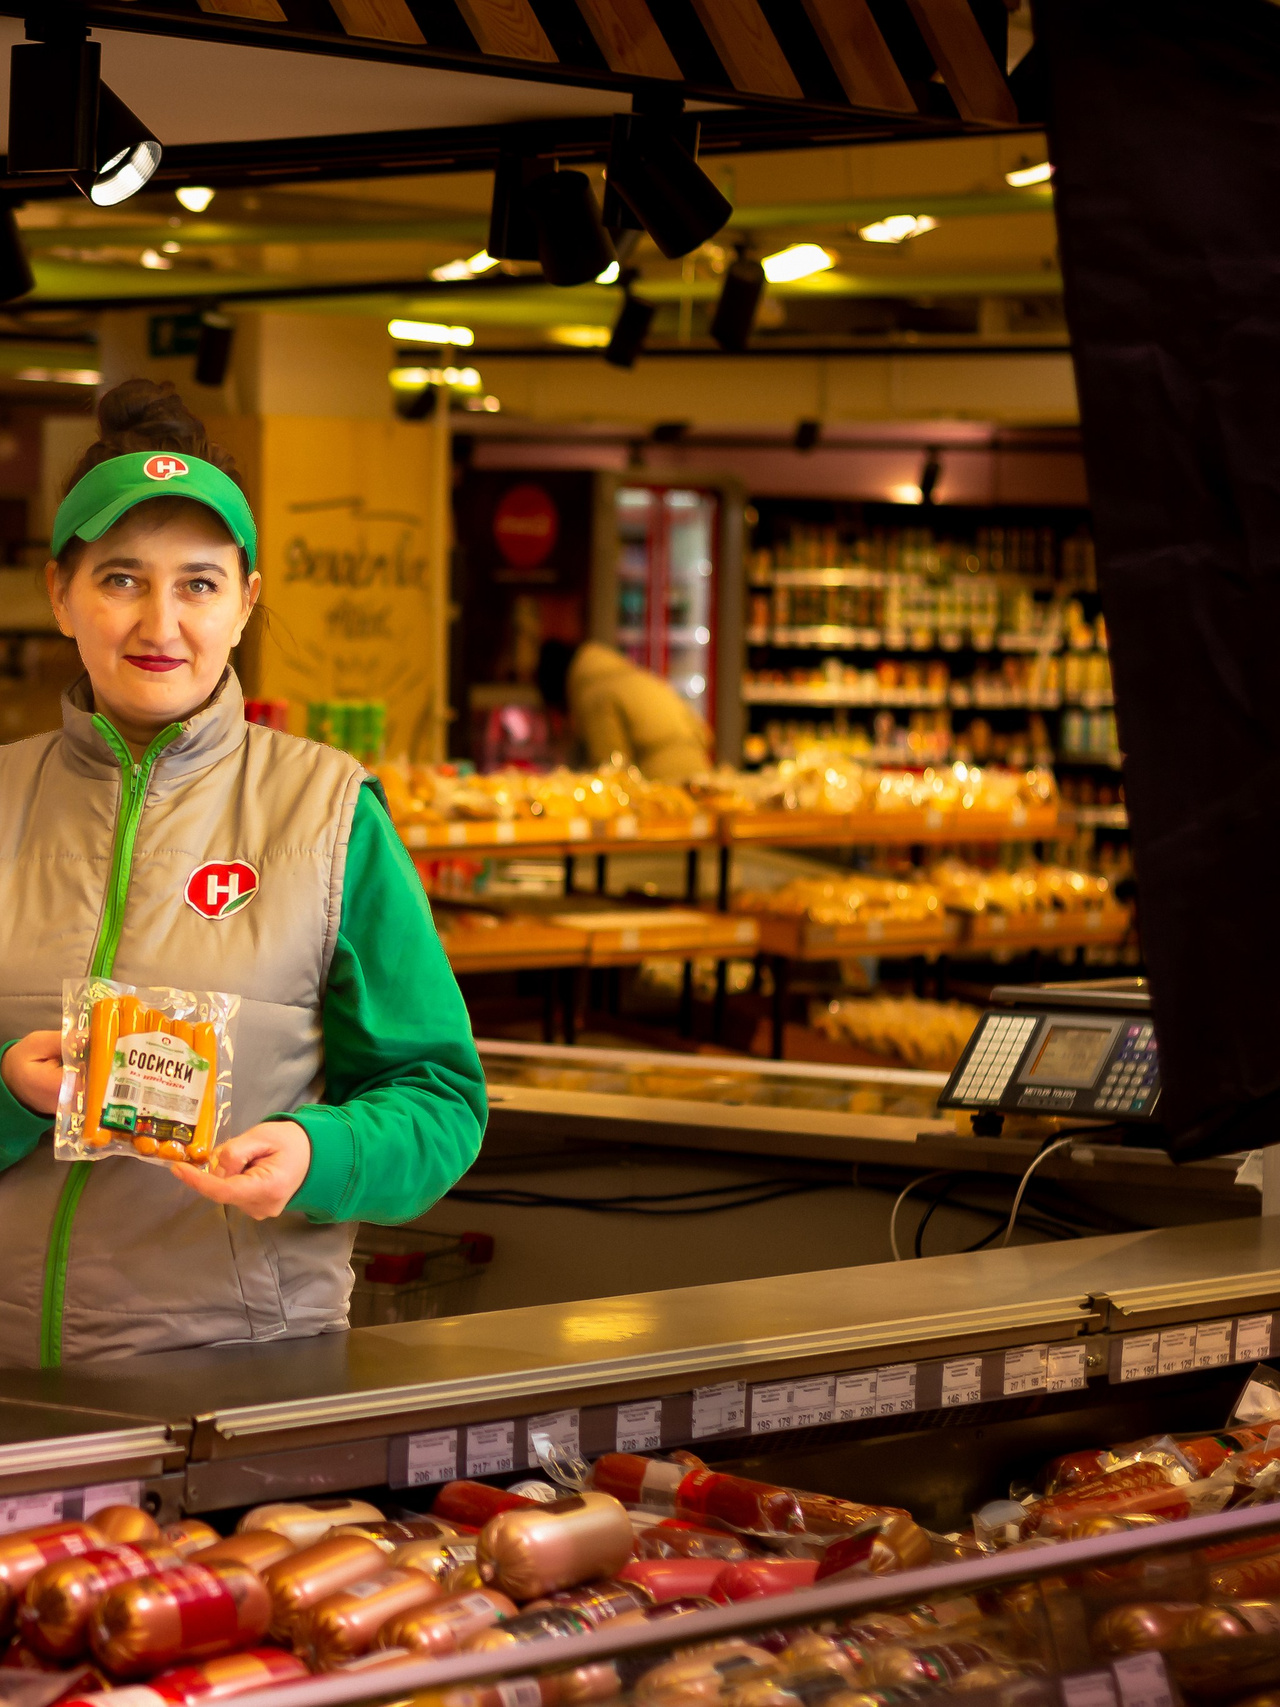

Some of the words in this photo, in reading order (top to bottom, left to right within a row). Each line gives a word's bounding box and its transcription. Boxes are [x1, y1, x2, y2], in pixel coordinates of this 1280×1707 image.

[156, 460, 176, 474] Н
[206, 872, 240, 906] Н
[128, 1048, 194, 1084] СОСИСКИ
[1023, 1086, 1052, 1097] METTLER
[1052, 1088, 1077, 1099] TOLEDO
[1125, 1368, 1137, 1380] 217
[1051, 1379, 1064, 1391] 217
[966, 1390, 979, 1401] 135
[860, 1406, 873, 1417] 239
[880, 1402, 894, 1414] 576
[900, 1400, 913, 1411] 529
[757, 1421, 770, 1432] 195
[778, 1416, 791, 1428] 179
[798, 1414, 811, 1425] 271
[818, 1411, 832, 1422] 249
[622, 1439, 637, 1451] 228
[644, 1436, 658, 1448] 209
[472, 1462, 487, 1475] 217
[496, 1459, 511, 1471] 199
[414, 1471, 430, 1484] 206
[438, 1467, 454, 1480] 189
